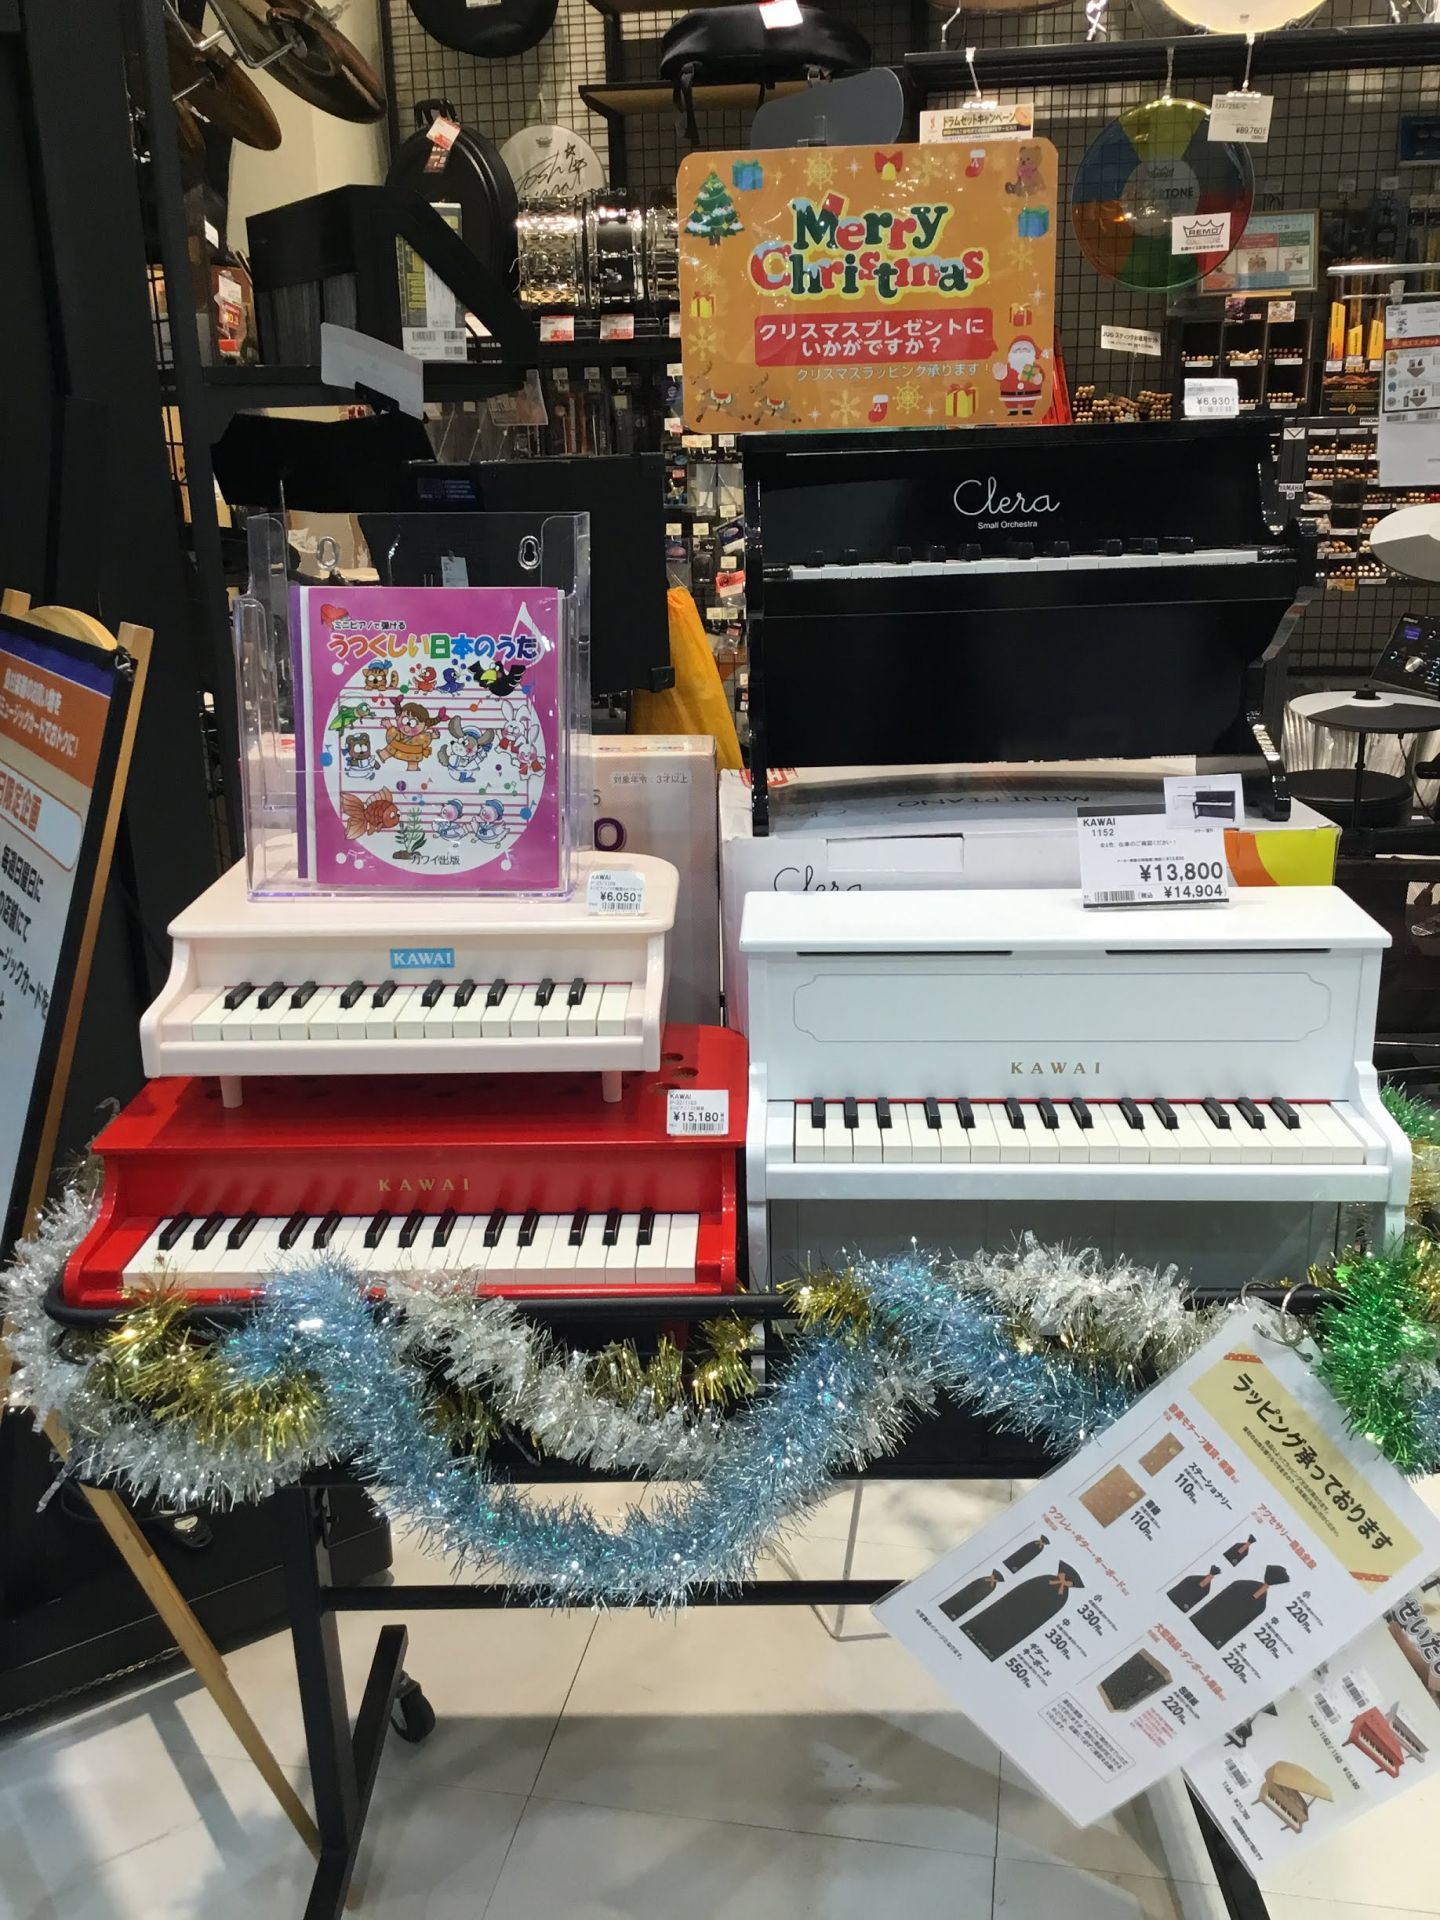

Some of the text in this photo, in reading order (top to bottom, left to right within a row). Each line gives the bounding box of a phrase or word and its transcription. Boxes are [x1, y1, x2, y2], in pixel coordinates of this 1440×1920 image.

[790, 194, 951, 252] Merry
[1188, 227, 1220, 236] REMO
[750, 242, 985, 298] Christmas
[759, 316, 985, 341] クリスマスプレゼントに
[801, 337, 942, 358] いかがですか？
[953, 476, 1060, 516] Clera
[977, 520, 1038, 530] Small Orchestra
[328, 632, 538, 660] うつくしい日本のうた
[1082, 817, 1117, 827] KAWAI
[1091, 828, 1115, 838] 1152
[410, 854, 461, 867] カワイ出版
[1139, 861, 1224, 882] ¥13,800
[600, 891, 637, 902] ¥6,050
[393, 951, 452, 967] KAWAI
[1009, 1061, 1101, 1075] KAWAI
[673, 1111, 719, 1122] ¥15,180
[378, 1177, 471, 1192] KAWAI
[1231, 1372, 1393, 1552] ラッピング承っております
[1188, 1462, 1234, 1510] ステーショナリー
